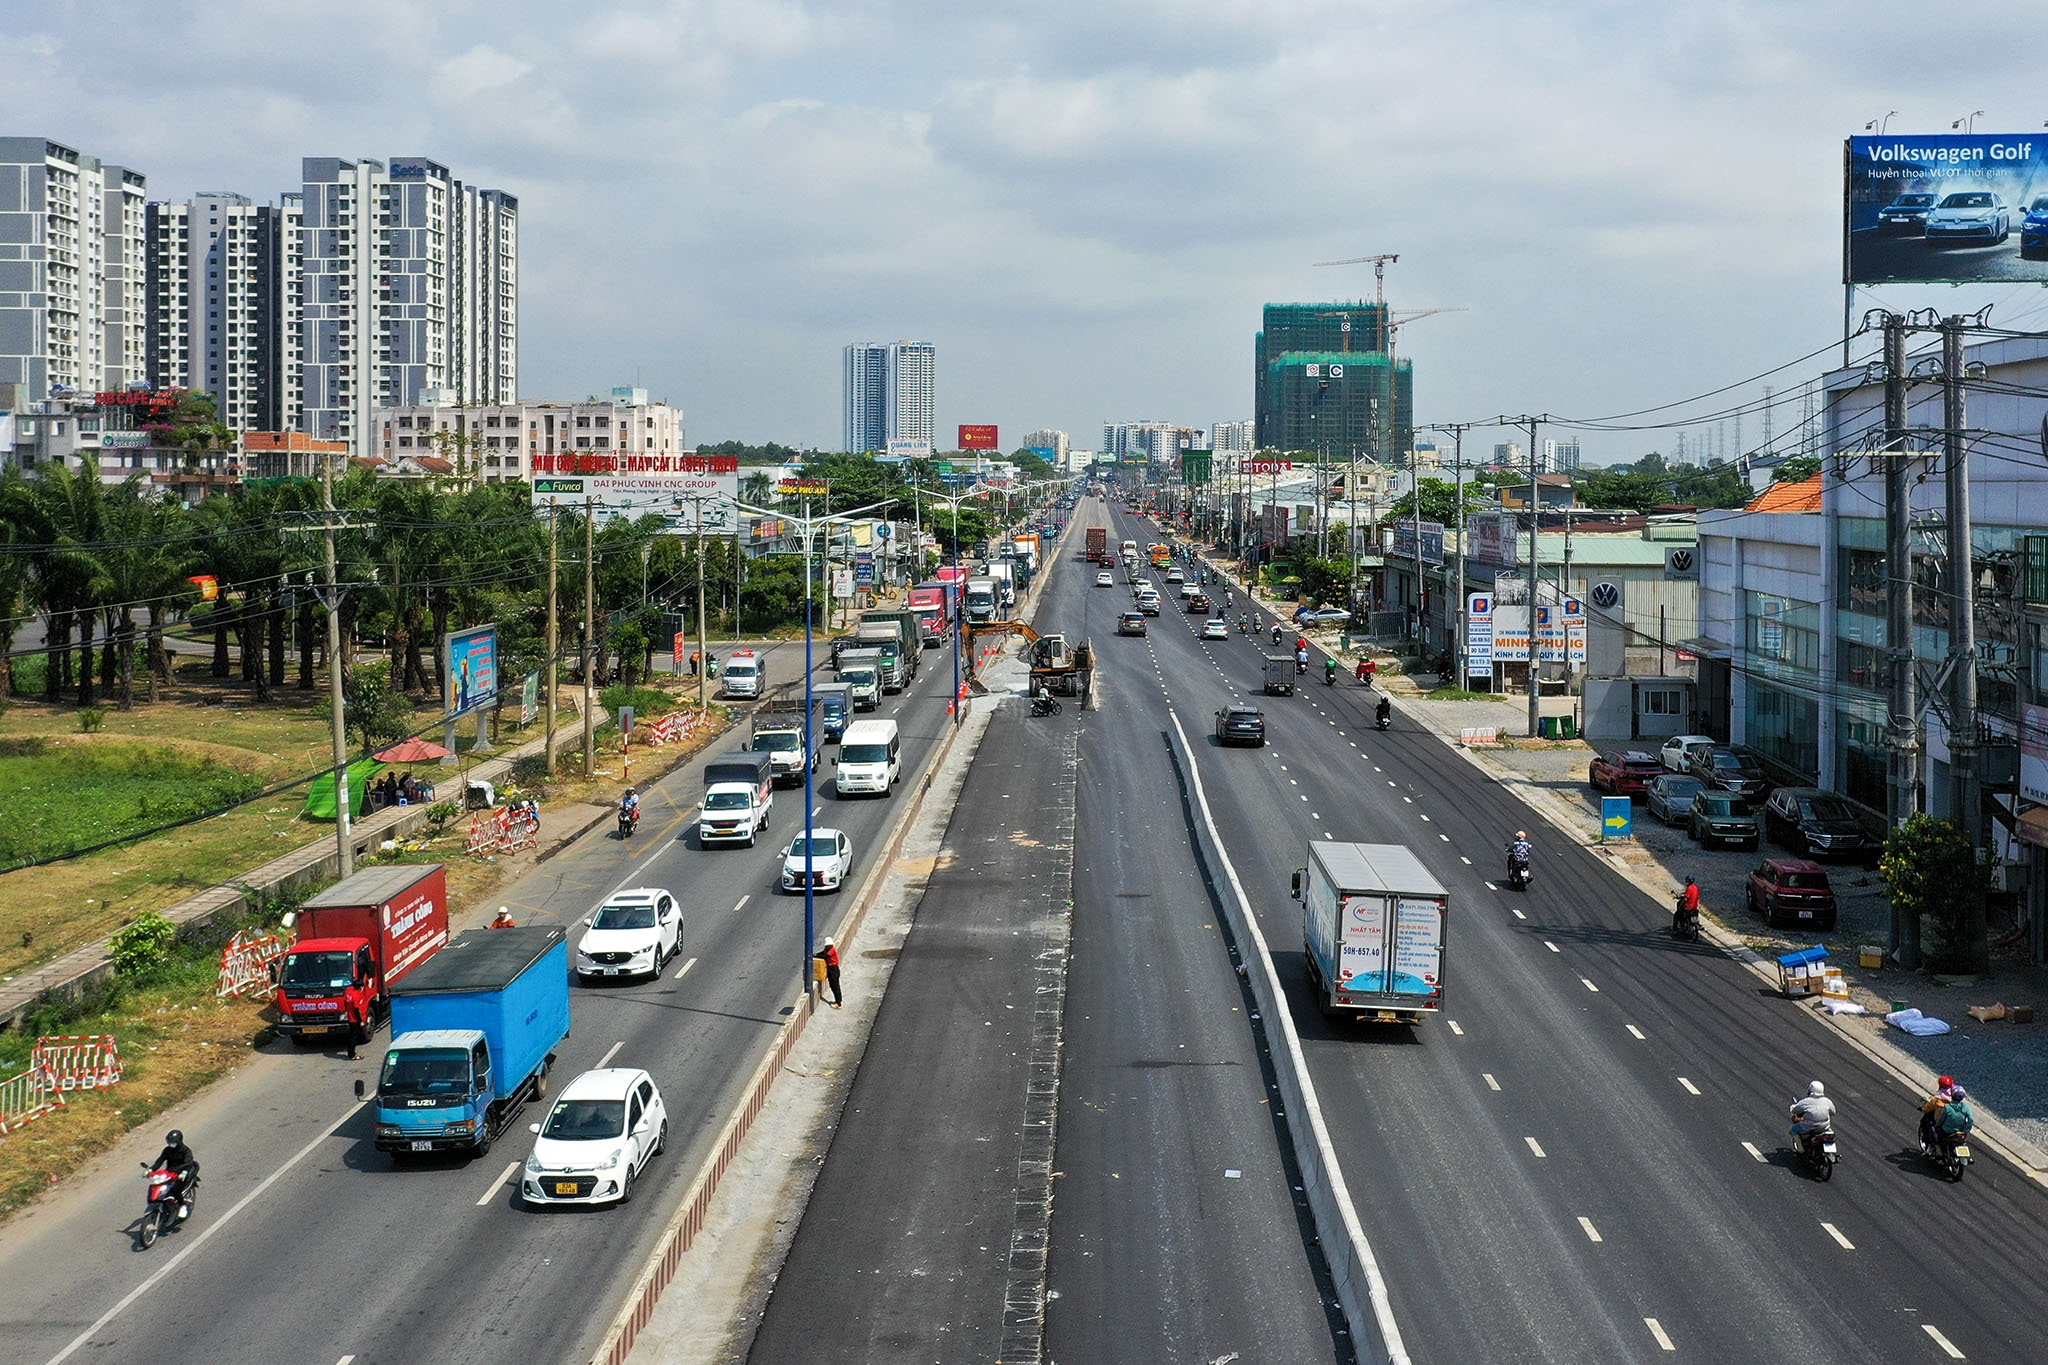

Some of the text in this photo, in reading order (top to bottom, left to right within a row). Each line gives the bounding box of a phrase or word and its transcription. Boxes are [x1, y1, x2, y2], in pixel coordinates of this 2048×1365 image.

[1868, 142, 2032, 164] Volkswagen Golf
[390, 163, 424, 178] Setia
[1868, 167, 1899, 180] Huyền
[1902, 168, 1928, 180] thoại
[1964, 168, 1984, 177] thời
[1986, 169, 2007, 179] gian
[117, 392, 150, 405] CAFE
[627, 452, 650, 472] MÁY
[653, 449, 671, 472] CẮT
[673, 456, 706, 472] LASER
[639, 480, 662, 488] VINH
[664, 480, 683, 488] CNC
[684, 480, 717, 488] GROUP
[1495, 638, 1530, 648] MINH
[407, 1099, 436, 1107] ISUZU
